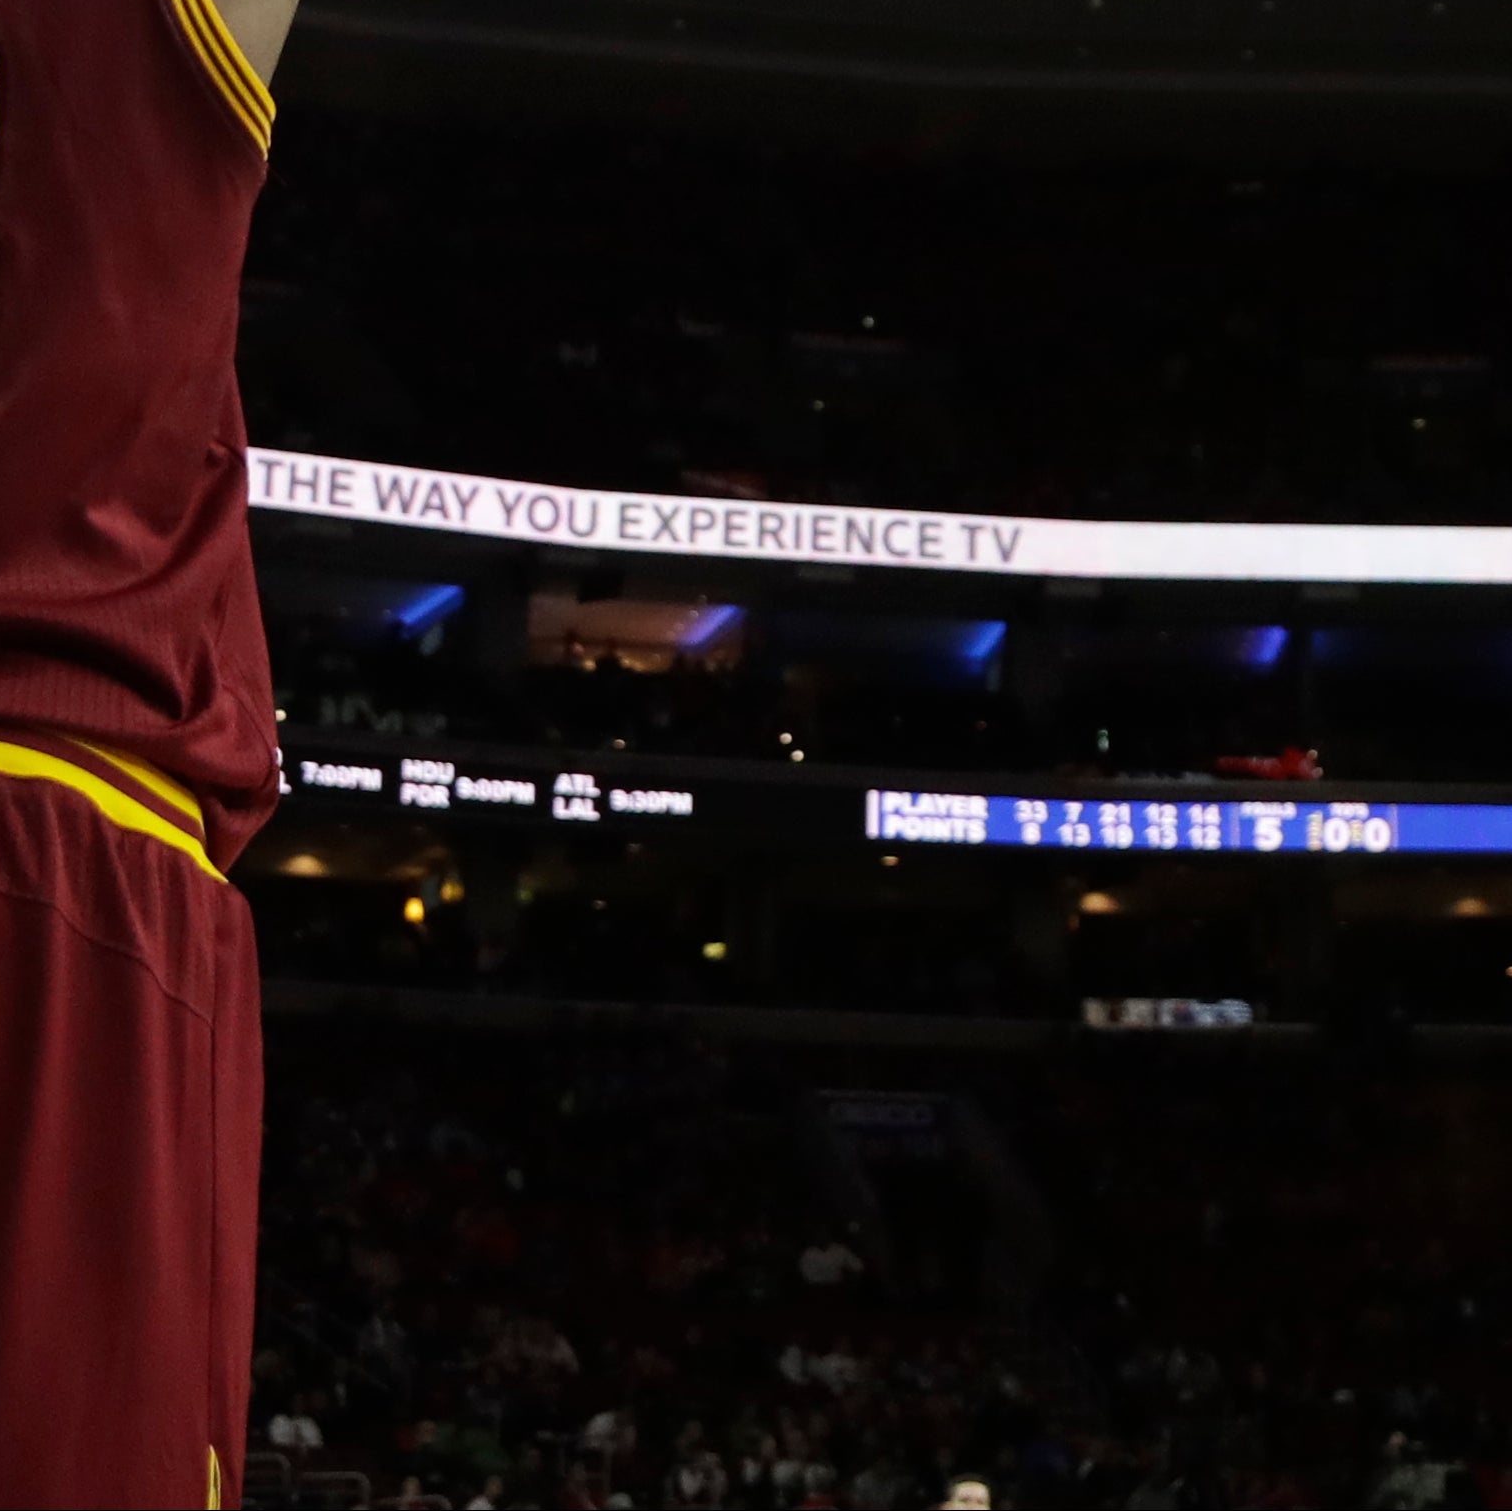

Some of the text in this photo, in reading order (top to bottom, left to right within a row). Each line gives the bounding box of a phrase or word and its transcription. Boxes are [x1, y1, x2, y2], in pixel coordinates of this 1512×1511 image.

[257, 458, 1022, 563] THE WAY YOU EXPERIENCE TV
[300, 761, 383, 792] 7:00PM
[400, 757, 456, 786] HOU
[553, 772, 601, 799] ATL
[399, 782, 451, 809] POR
[552, 795, 601, 821] LAL
[609, 789, 694, 816] 9:30PM
[882, 790, 989, 820] PLAYER
[1063, 801, 1084, 824] 7
[1099, 803, 1131, 826] 21
[882, 813, 987, 844] POINTS
[1253, 815, 1285, 853] 5
